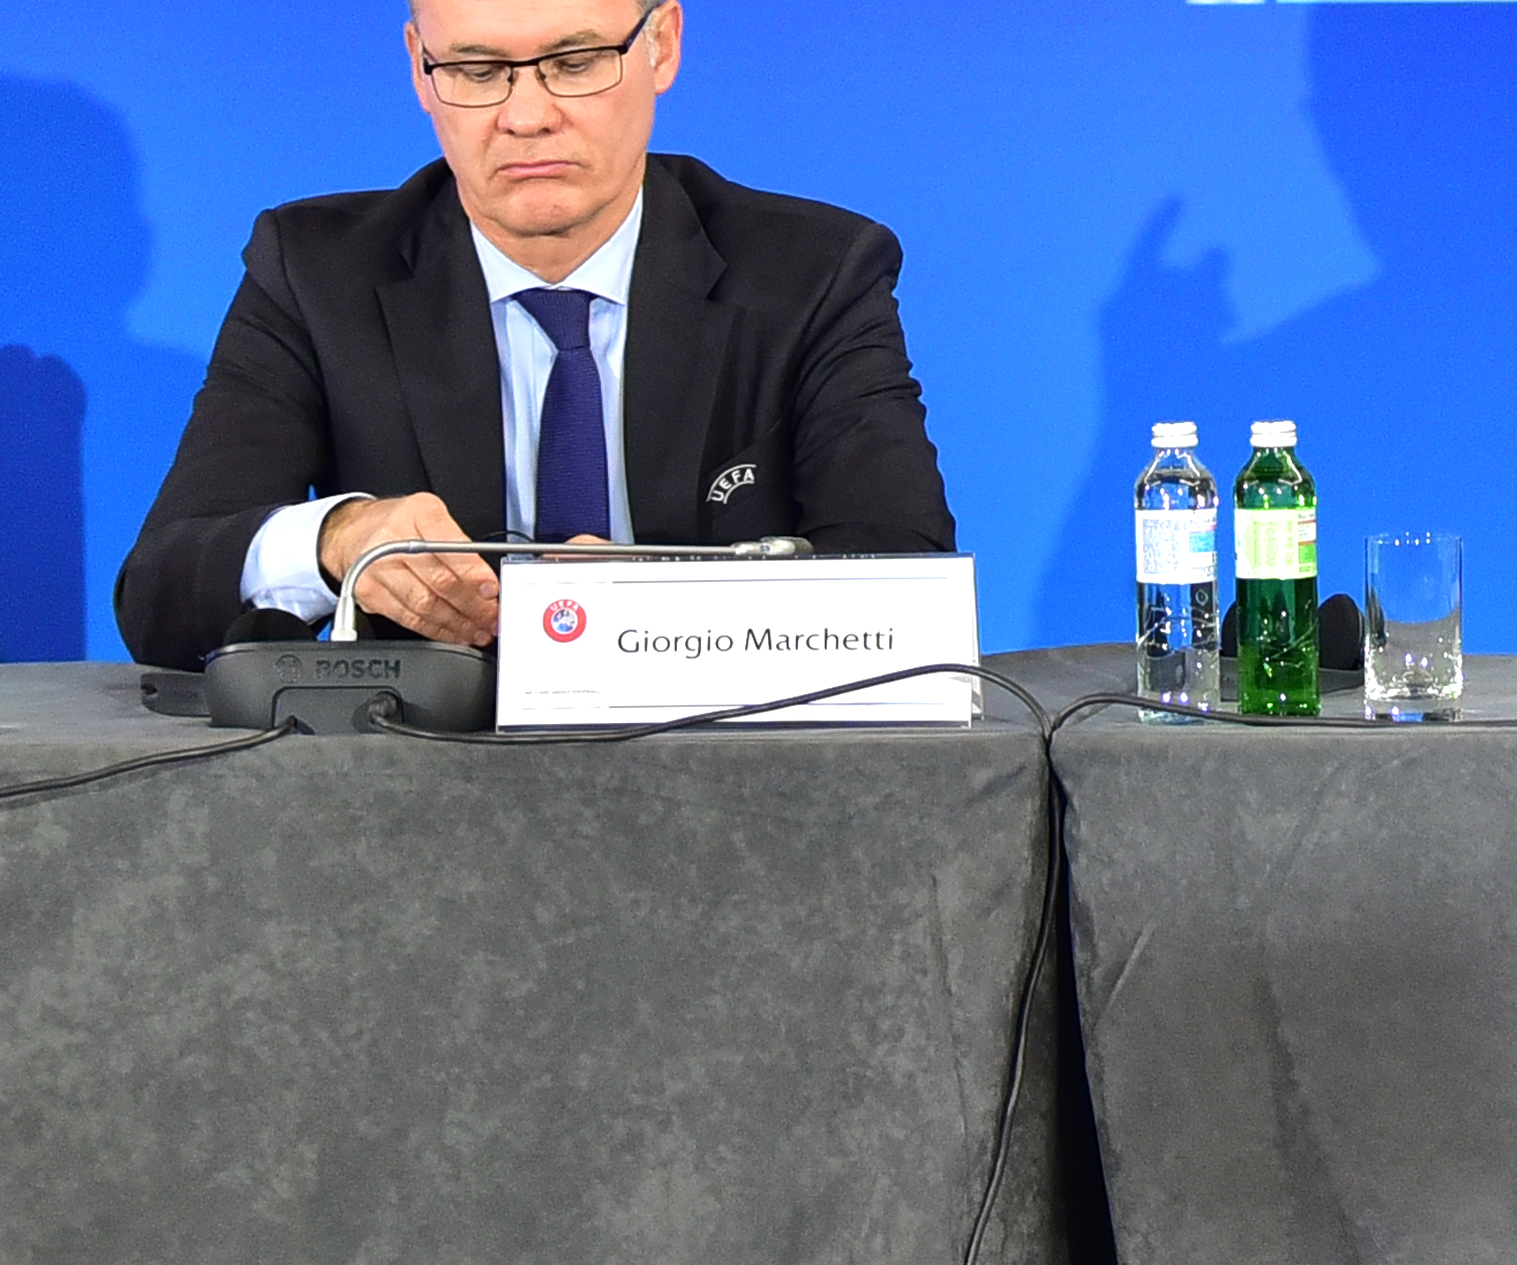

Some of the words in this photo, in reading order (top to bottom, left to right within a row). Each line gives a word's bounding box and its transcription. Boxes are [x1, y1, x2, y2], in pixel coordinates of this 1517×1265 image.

[710, 468, 755, 502] UEFA
[617, 629, 734, 660] Giorgio
[744, 627, 894, 652] Marchetti
[315, 659, 402, 679] BOSCH
